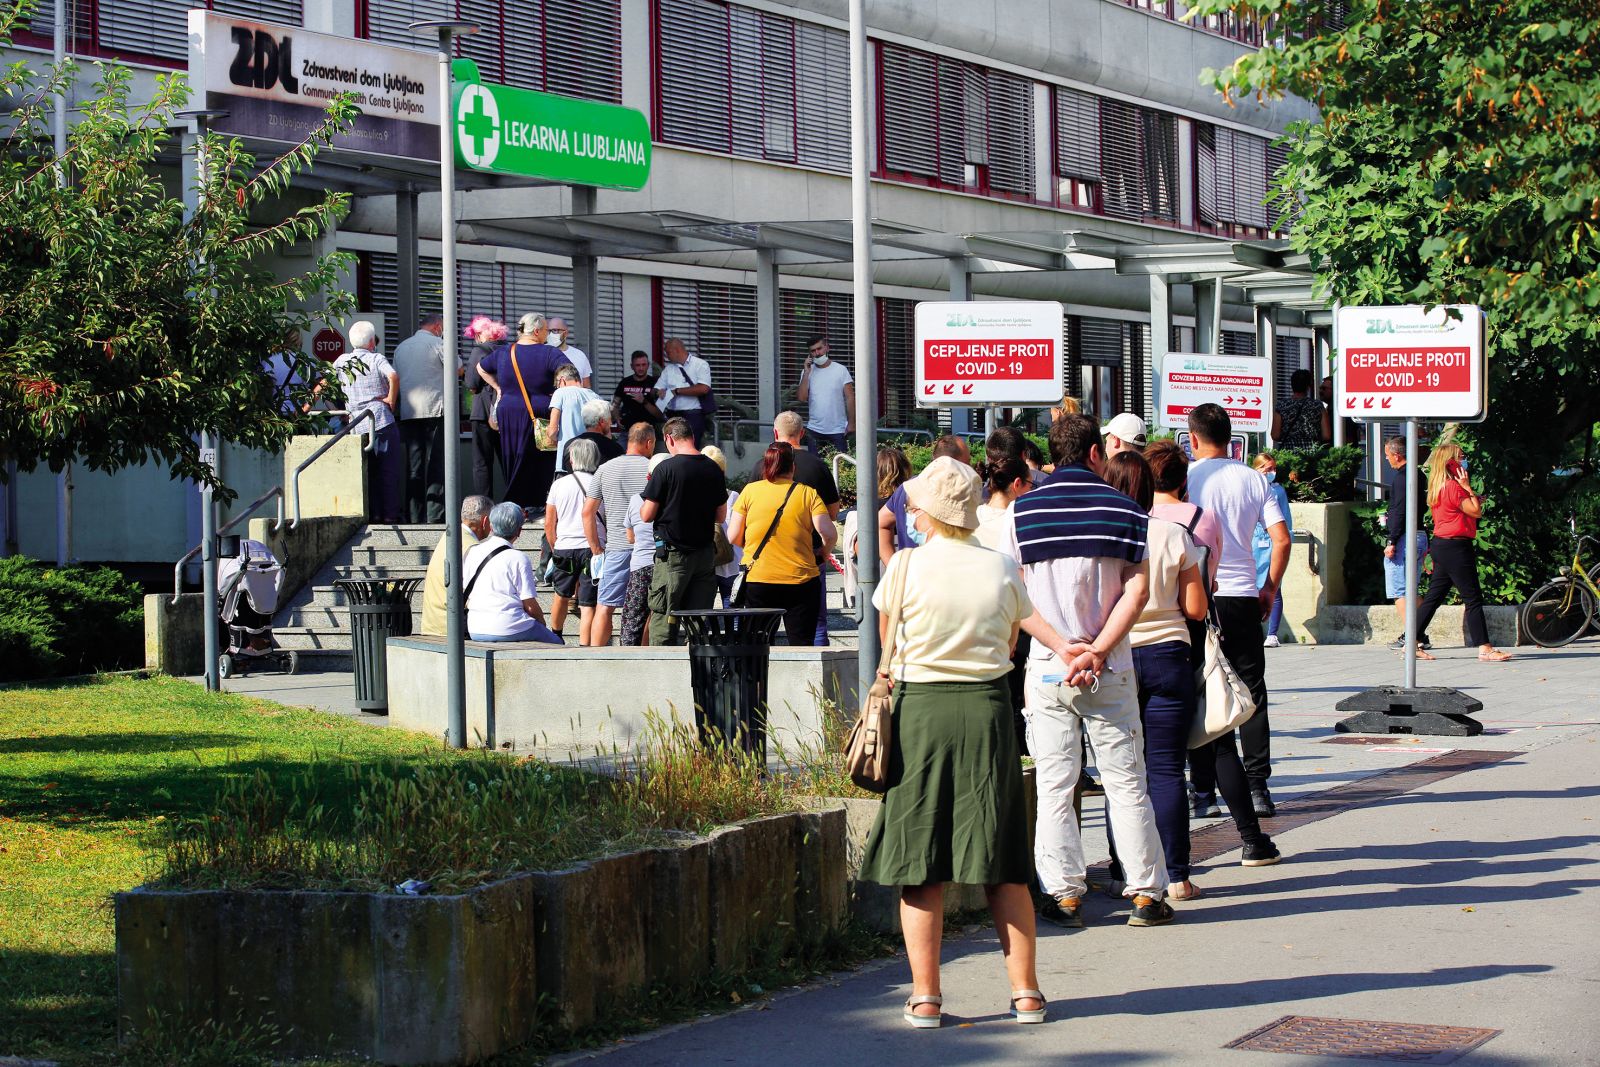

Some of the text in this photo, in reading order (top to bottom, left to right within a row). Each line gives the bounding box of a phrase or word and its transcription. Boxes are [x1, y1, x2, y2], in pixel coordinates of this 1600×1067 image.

[302, 59, 425, 96] Zdravstveni dom Ljubljana
[369, 94, 392, 109] Centre
[393, 97, 425, 115] Ljubljana
[504, 120, 646, 166] LEKARNA LJUBLJANA
[316, 341, 342, 351] STOP
[929, 343, 1049, 357] CEPLJENJE PROTI
[1350, 352, 1465, 367] CEPLJENJE PROTI
[955, 362, 997, 375] COVID
[1008, 362, 1023, 375] 19
[1221, 377, 1260, 385] KORONAVIRUS
[1375, 373, 1414, 387] COVID
[1425, 373, 1440, 387] 19
